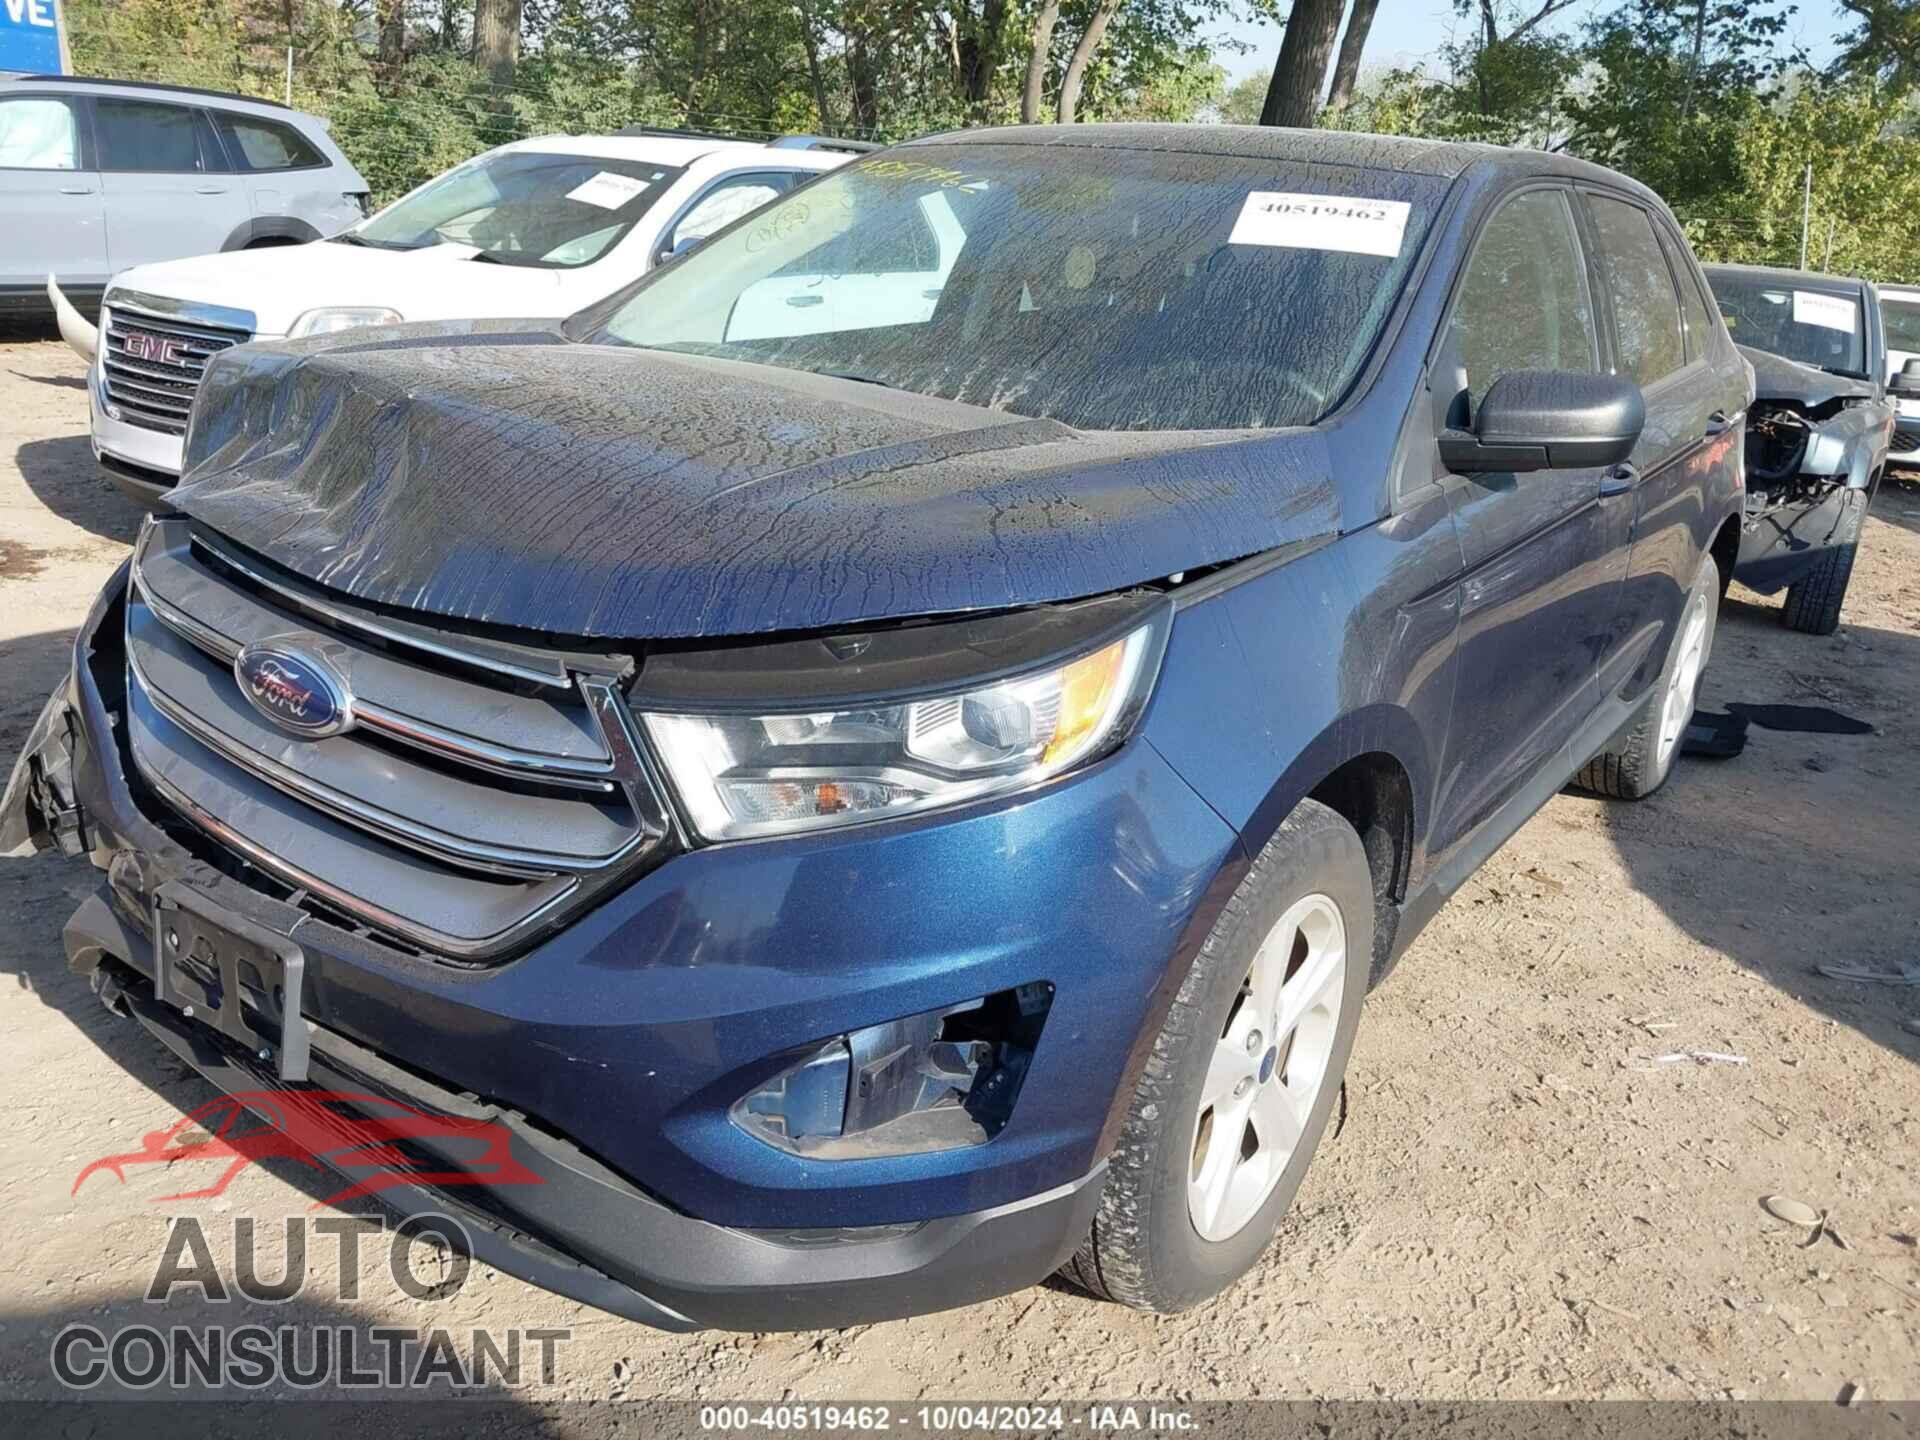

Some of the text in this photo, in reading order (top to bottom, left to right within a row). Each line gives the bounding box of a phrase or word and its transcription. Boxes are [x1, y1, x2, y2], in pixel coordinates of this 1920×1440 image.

[1260, 203, 1386, 220] 40519462
[125, 333, 188, 368] GMC
[252, 659, 313, 717] Ford
